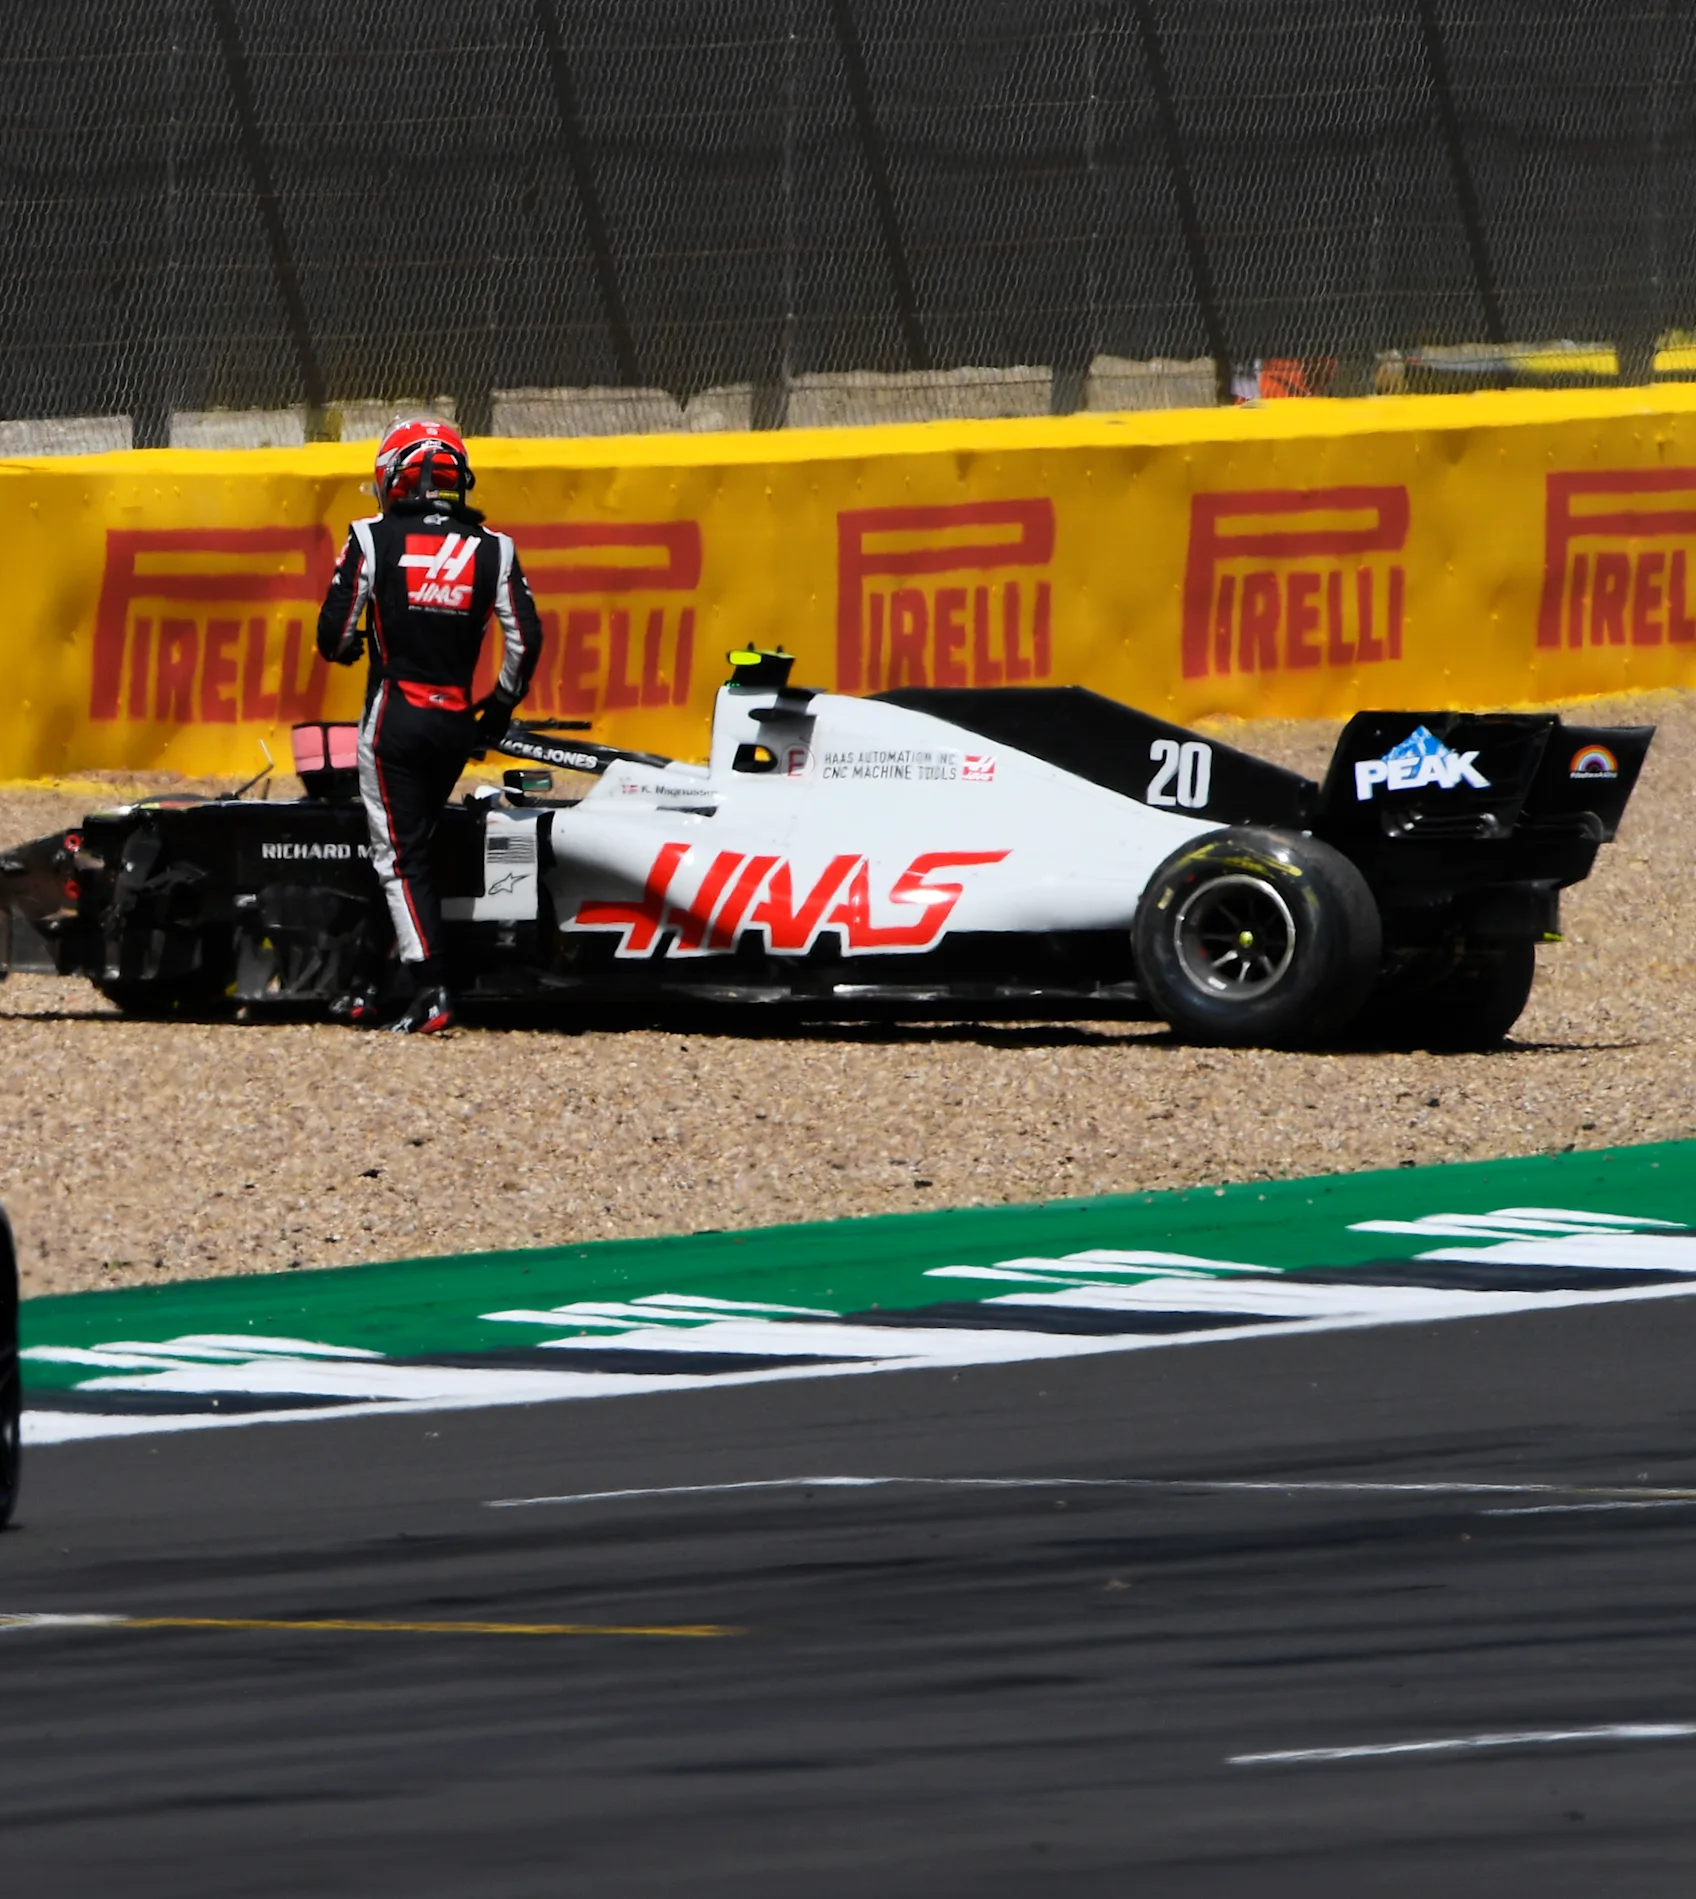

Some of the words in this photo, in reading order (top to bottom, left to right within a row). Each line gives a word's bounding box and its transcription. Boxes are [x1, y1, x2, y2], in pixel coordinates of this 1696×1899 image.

[408, 583, 473, 606] HAAS
[836, 497, 1056, 690] PIRELLI
[1182, 485, 1410, 679] PIRELLI
[1536, 468, 1696, 649] PIREL
[89, 525, 334, 722] PIRELLI
[470, 520, 702, 715] PRELLI
[822, 767, 848, 779] CNC
[852, 765, 912, 779] MACHINE
[918, 766, 957, 780] TOOLS
[824, 752, 853, 764] HAAS
[859, 751, 932, 764] AUTOMATION
[937, 753, 956, 765] NC
[1146, 739, 1212, 808] 20
[1355, 750, 1490, 801] PEAK
[262, 843, 351, 859] RICHARD
[560, 842, 1012, 958] HAAS
